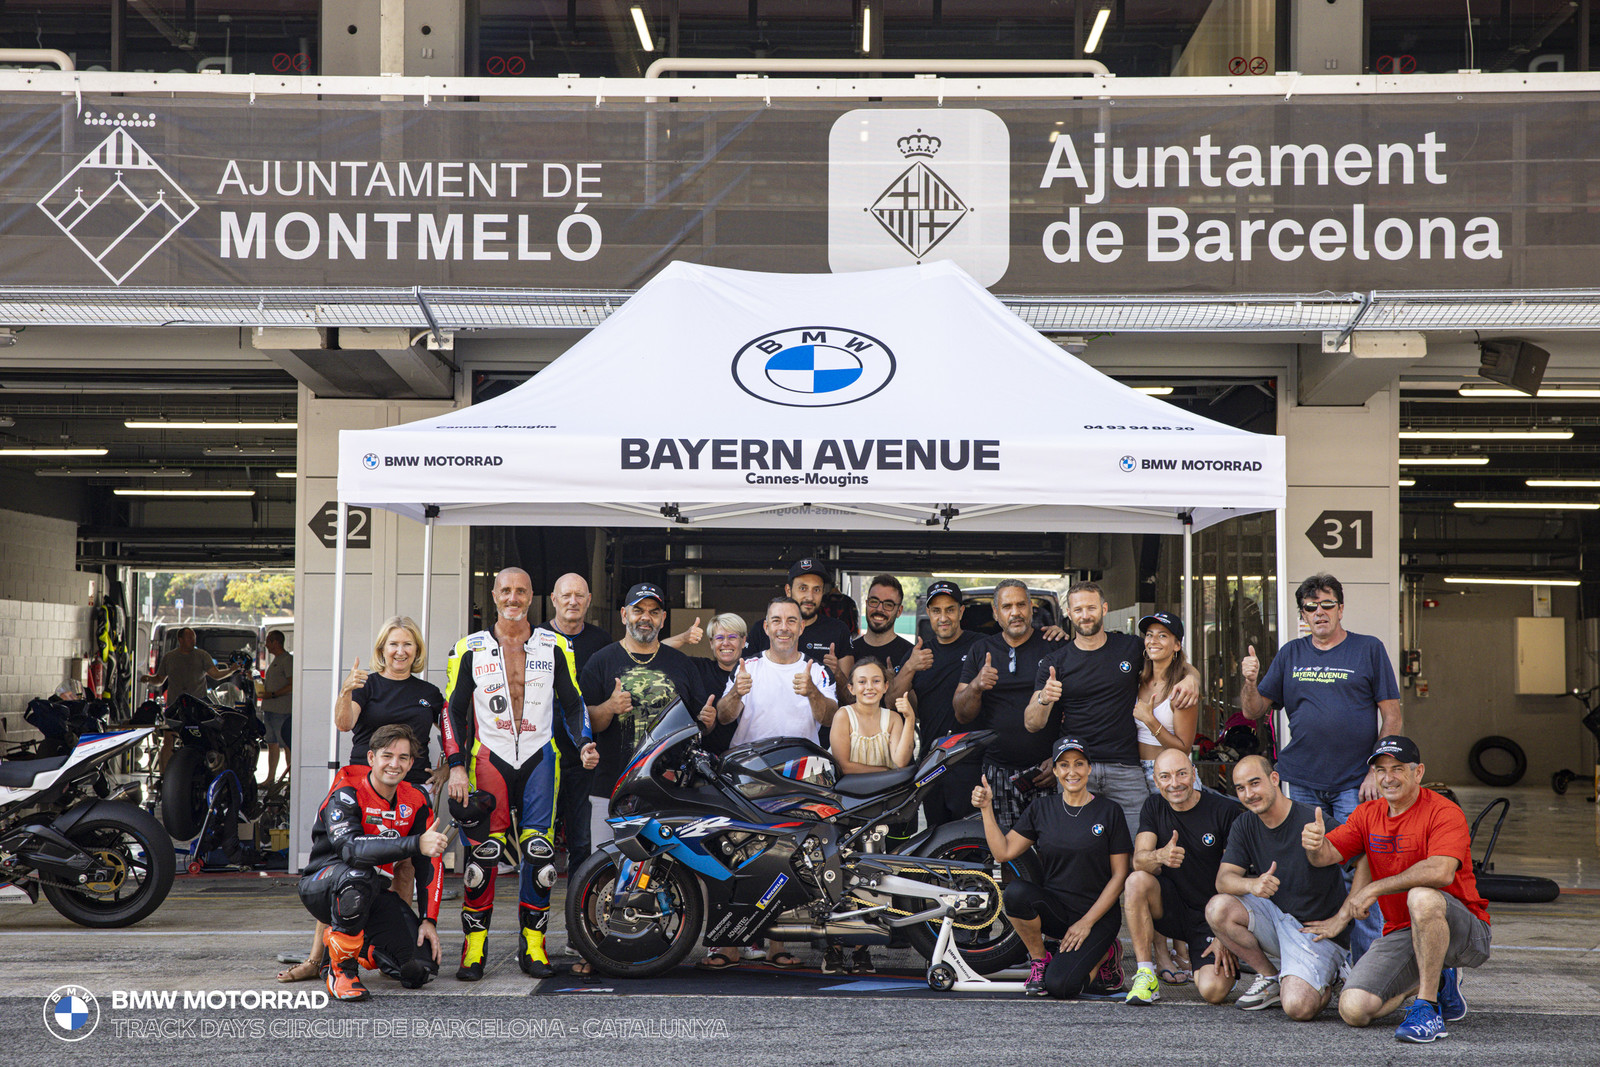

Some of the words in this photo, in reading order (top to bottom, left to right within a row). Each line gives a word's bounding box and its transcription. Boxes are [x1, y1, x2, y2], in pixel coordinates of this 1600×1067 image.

[216, 160, 528, 198] AJUNTAMENT
[542, 162, 603, 198] DE
[1040, 132, 1447, 204] Ajuntament
[220, 203, 603, 262] MONTMELÓ
[1042, 207, 1124, 264] de
[1147, 204, 1503, 264] Barcelona
[755, 331, 873, 355] BMW
[384, 456, 420, 467] BMW
[423, 456, 504, 467] MOTORRAD
[620, 438, 803, 471] BAYERN
[812, 439, 1000, 471] AVENUE
[1141, 459, 1178, 471] BMW
[1181, 459, 1263, 472] MOTORRAD
[745, 473, 869, 488] Cannes-Mougins
[324, 509, 367, 540] 32
[1323, 518, 1362, 550] 31
[1410, 1015, 1443, 1037] PARIS
